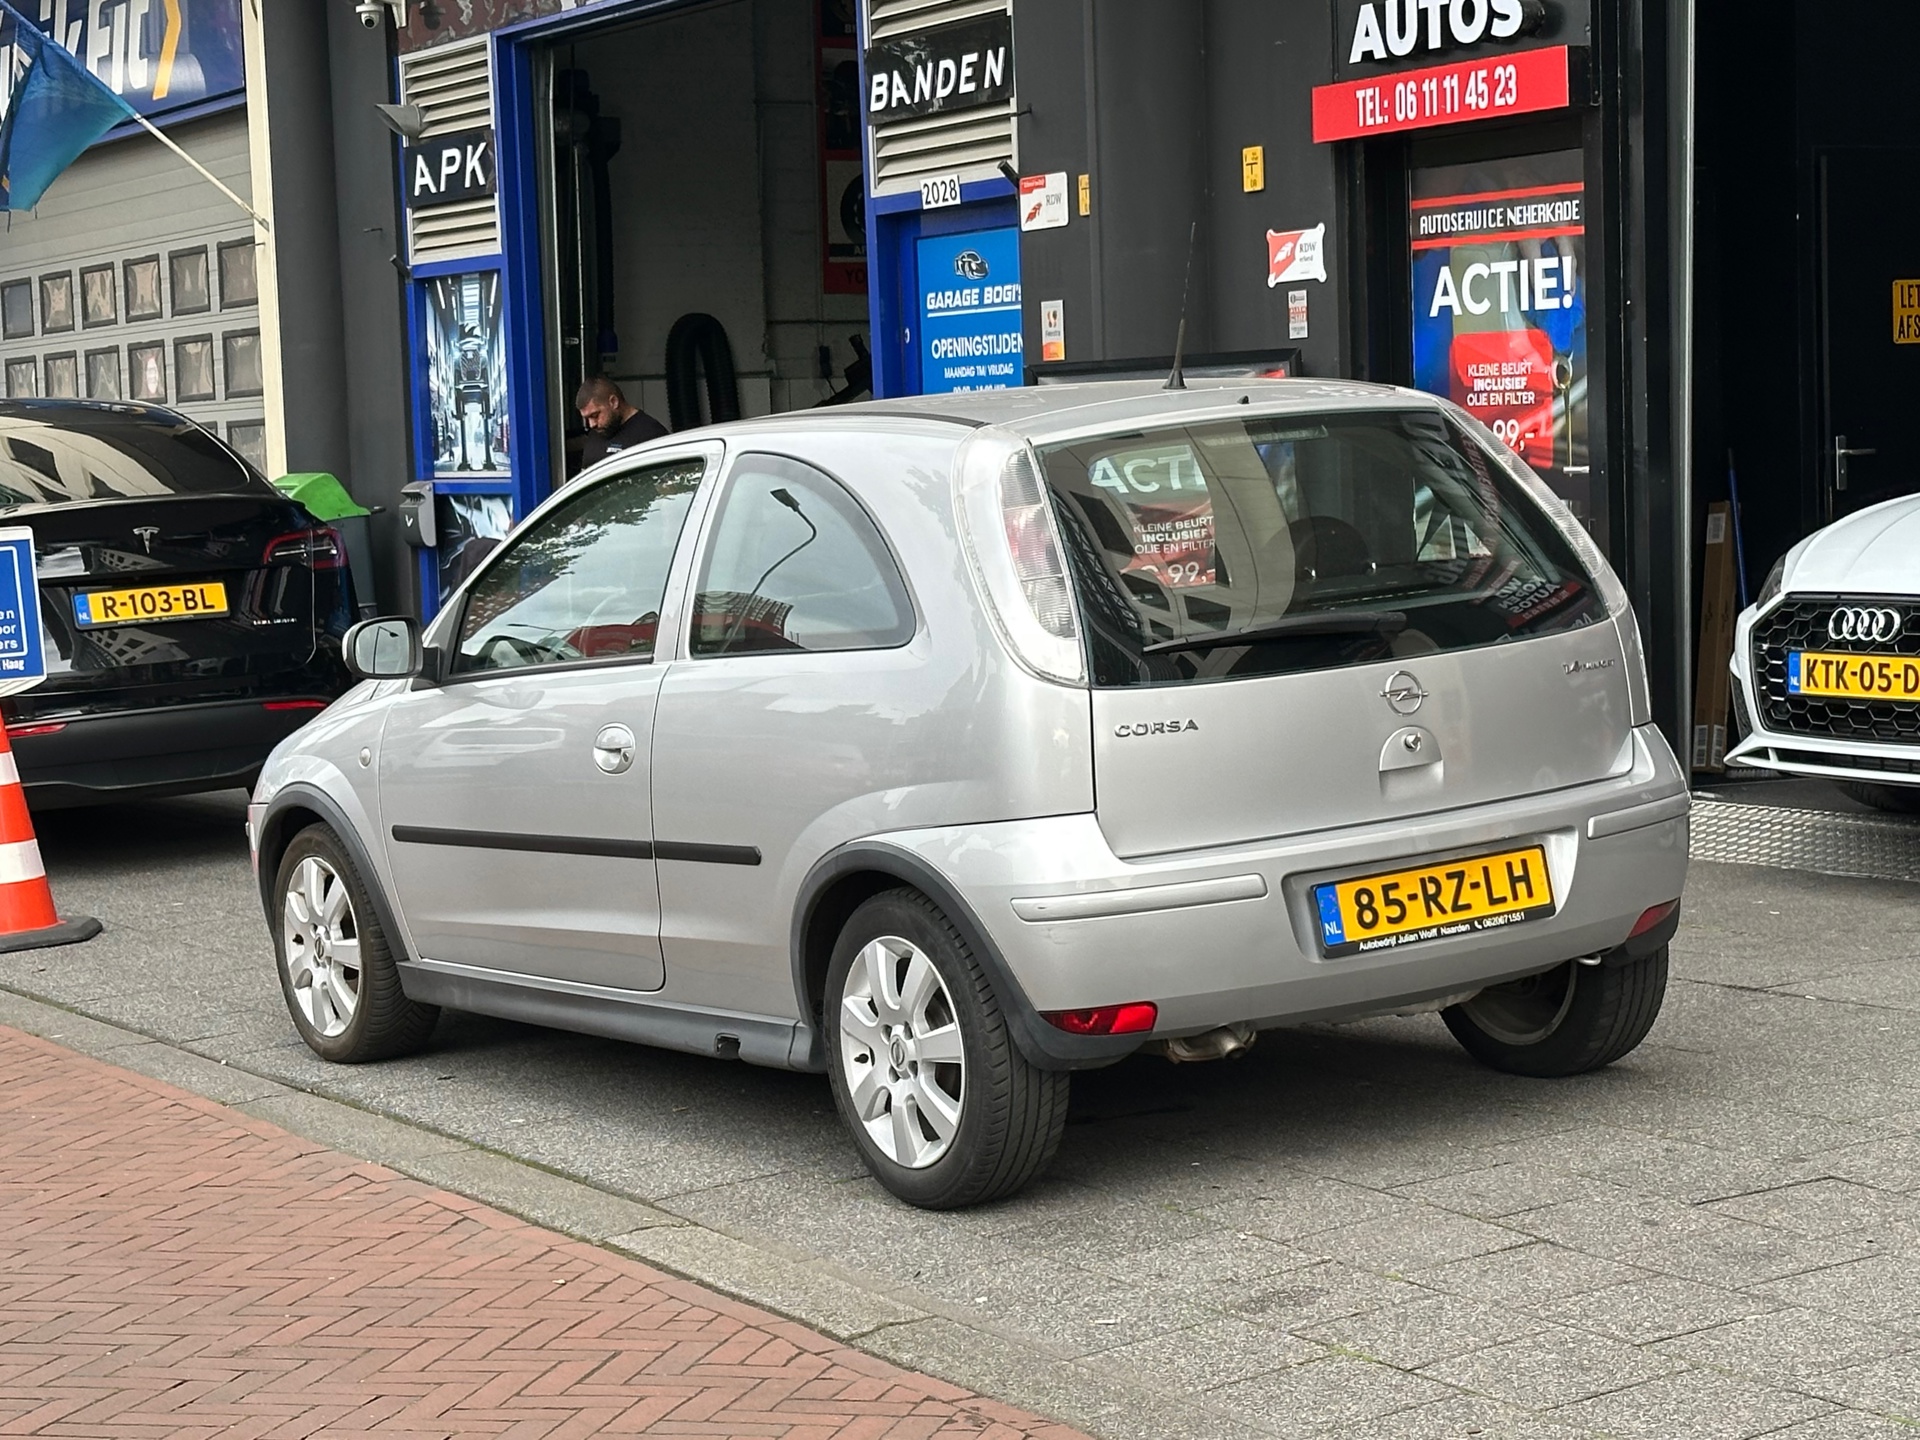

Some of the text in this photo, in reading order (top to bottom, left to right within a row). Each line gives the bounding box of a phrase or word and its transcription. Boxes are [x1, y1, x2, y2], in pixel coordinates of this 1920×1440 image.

[1348, 0, 1524, 65] AUTOS
[869, 46, 1006, 113] BANDEN
[1355, 63, 1518, 128] TEL: 06 11 11 45 23
[413, 141, 488, 197] APK
[922, 178, 958, 206] 2028
[1045, 193, 1062, 206] RDW
[1419, 199, 1581, 236] AUTOSERVICE NEHERKADE
[1299, 242, 1317, 253] RDW
[1428, 254, 1574, 319] ACTIE!
[926, 287, 980, 310] GARAGE
[931, 331, 1024, 360] OPENINGSTIJDEN
[944, 365, 975, 379] MAANDAG
[987, 363, 1014, 376] VRIJDAG
[1467, 360, 1533, 377] KLEINE BEURT
[1473, 376, 1528, 392] INCLUSIEF
[1466, 391, 1535, 407] OLIE EN FILTER
[1133, 515, 1215, 534] KLEINE BEURT
[1142, 528, 1209, 544] INCLUSIEF
[1163, 541, 1180, 554] EN
[1181, 538, 1215, 552] FILTER
[102, 587, 216, 619] R-103-BL
[78, 611, 90, 621] NL
[2, 658, 25, 671] Haag
[1805, 658, 1920, 694] KTK-05-D
[1114, 718, 1199, 738] CORSA
[1353, 857, 1535, 931] 85-RZ-LH
[1324, 920, 1342, 937] NL
[1358, 934, 1397, 952] Autobedrijf
[1397, 931, 1419, 944] Julian
[1418, 927, 1438, 940] Wolff
[1440, 922, 1471, 937] Naarden
